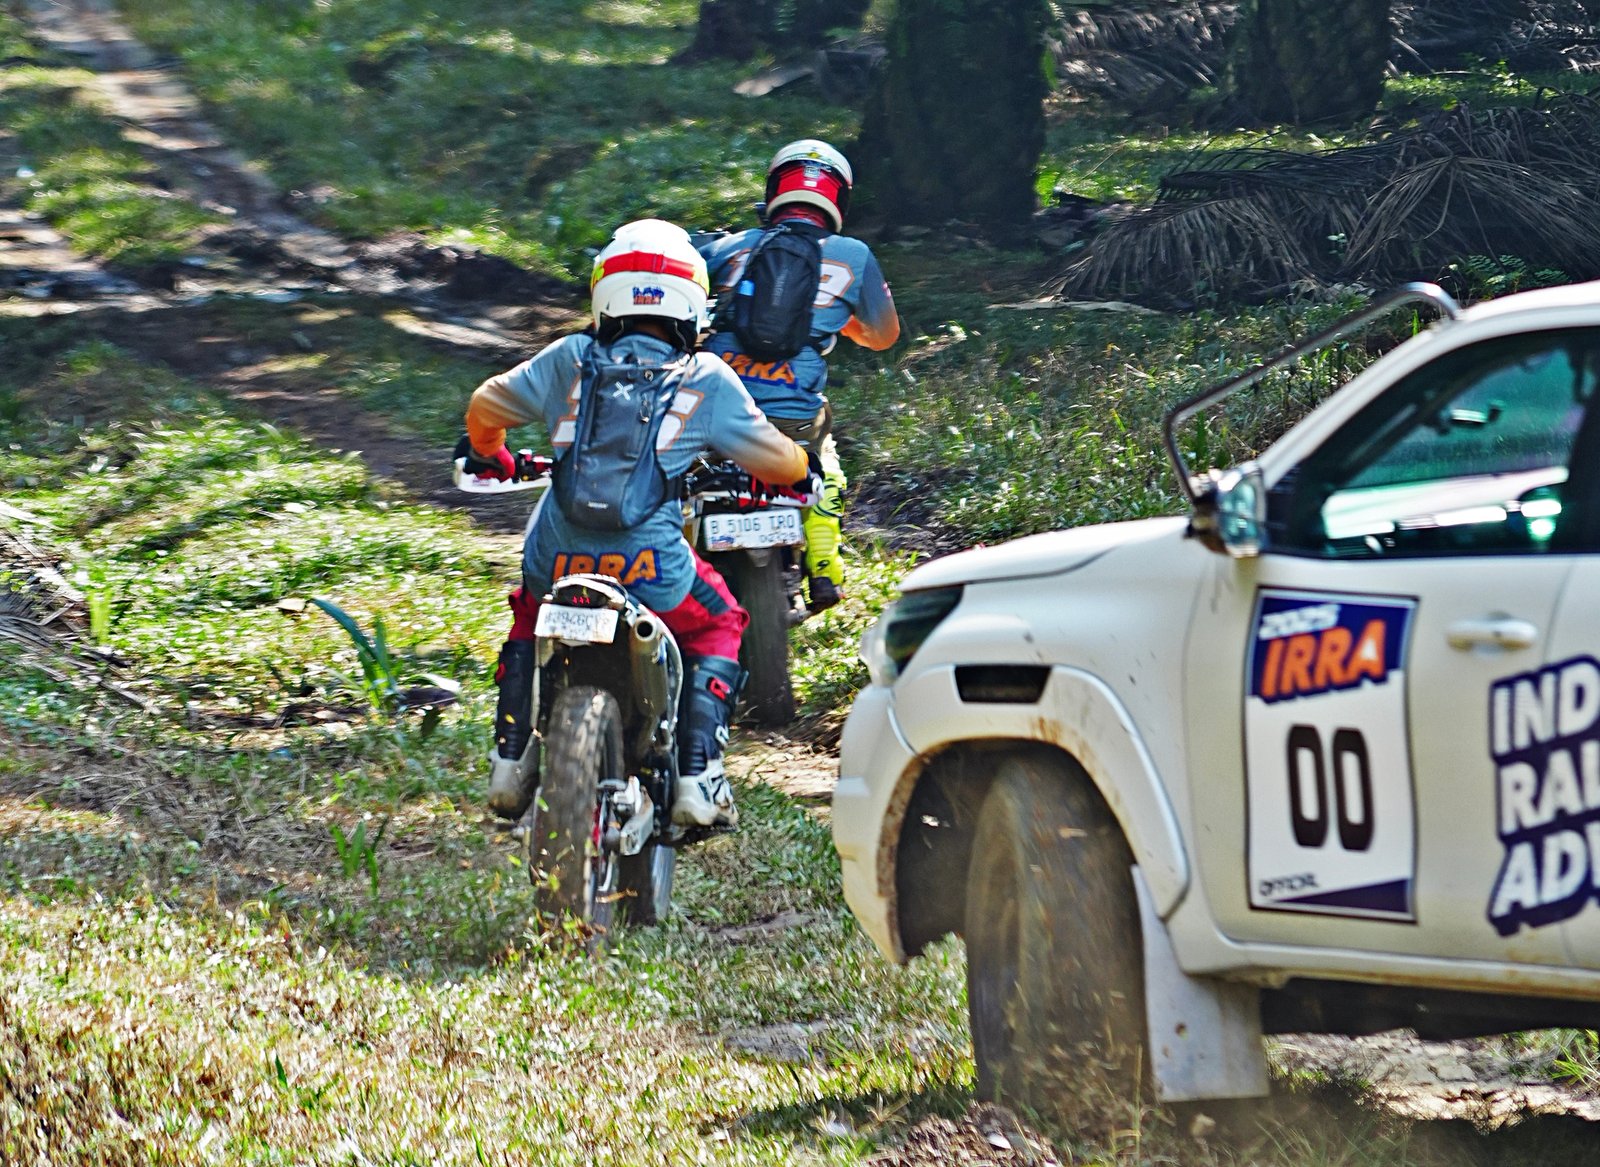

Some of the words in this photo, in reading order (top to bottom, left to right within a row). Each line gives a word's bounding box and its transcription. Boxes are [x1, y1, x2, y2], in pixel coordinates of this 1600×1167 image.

[710, 520, 719, 535] B
[727, 517, 760, 533] 5106
[552, 548, 657, 584] IRRA
[1260, 619, 1386, 698] IRRA
[1493, 662, 1600, 755] IND
[1286, 723, 1374, 853] 00
